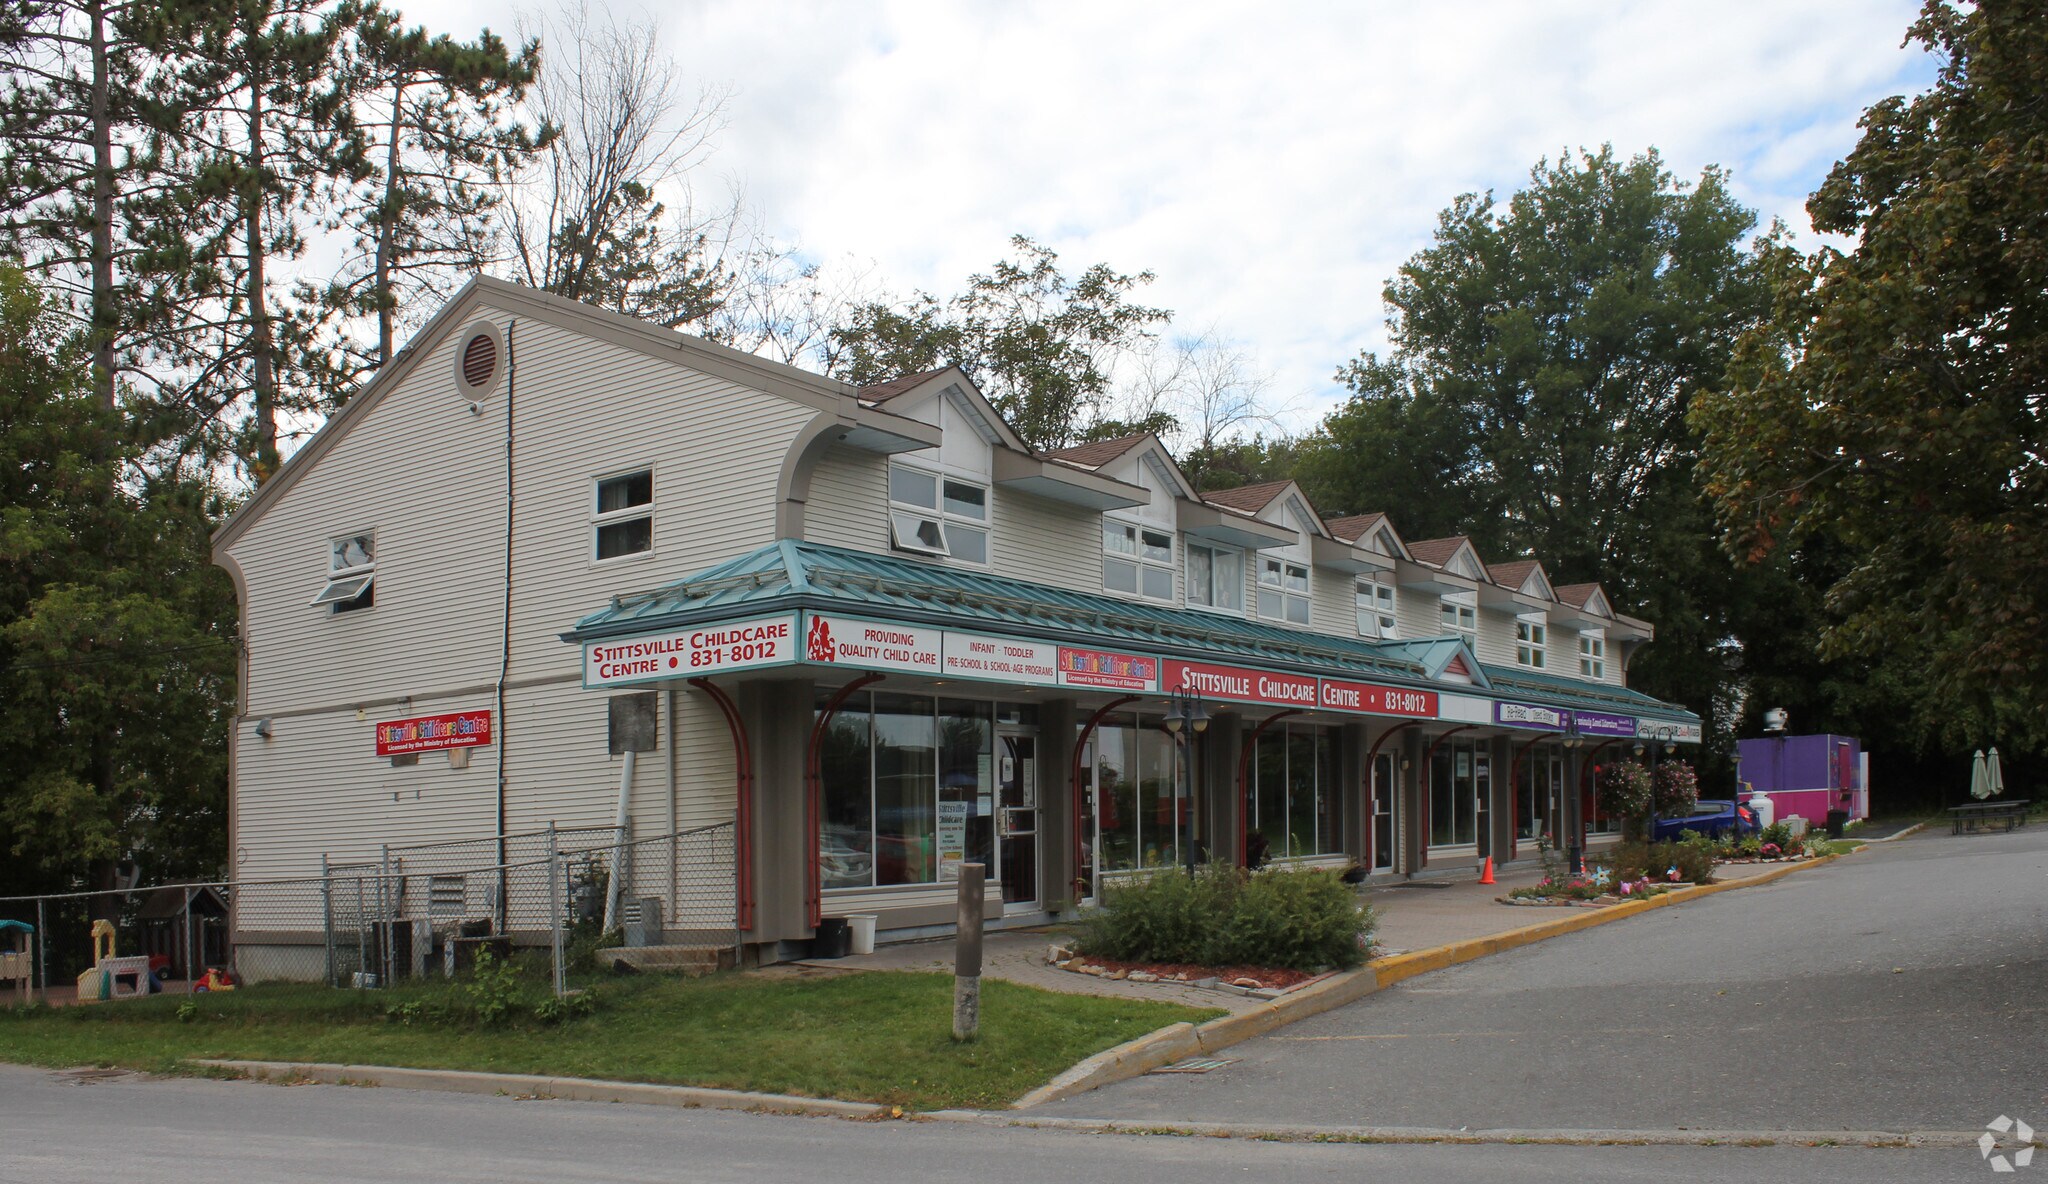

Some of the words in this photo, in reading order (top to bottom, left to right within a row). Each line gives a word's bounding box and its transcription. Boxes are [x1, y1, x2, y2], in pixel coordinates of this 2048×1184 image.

[864, 629, 914, 647] PROVIDING
[690, 641, 776, 667] 831-8012
[839, 643, 879, 659] QUALITY
[883, 648, 909, 662] CHILD
[912, 651, 937, 665] CARE
[969, 642, 995, 655] INFANT
[1003, 645, 1034, 659] TODDLER
[947, 656, 981, 670] PRE-SCHOOL
[984, 660, 988, 670] &
[990, 661, 1024, 674] SCHOOL-AGE
[1025, 663, 1053, 677] PROGRAMS
[1062, 650, 1098, 672] Stittsville
[1099, 654, 1131, 676] Childcare
[1132, 659, 1154, 679] Centre
[1068, 674, 1087, 682] Licensed
[1088, 676, 1093, 684] by
[1102, 677, 1117, 686] Ministry
[1124, 678, 1144, 688] Education
[1385, 691, 1426, 713] 831-8012
[379, 723, 417, 744] Stittsville
[418, 720, 456, 738] Childcare
[458, 716, 488, 734] Centre
[387, 743, 408, 751] Licensed
[408, 742, 415, 750] by
[423, 739, 444, 748] Ministry
[450, 736, 477, 745] Education
